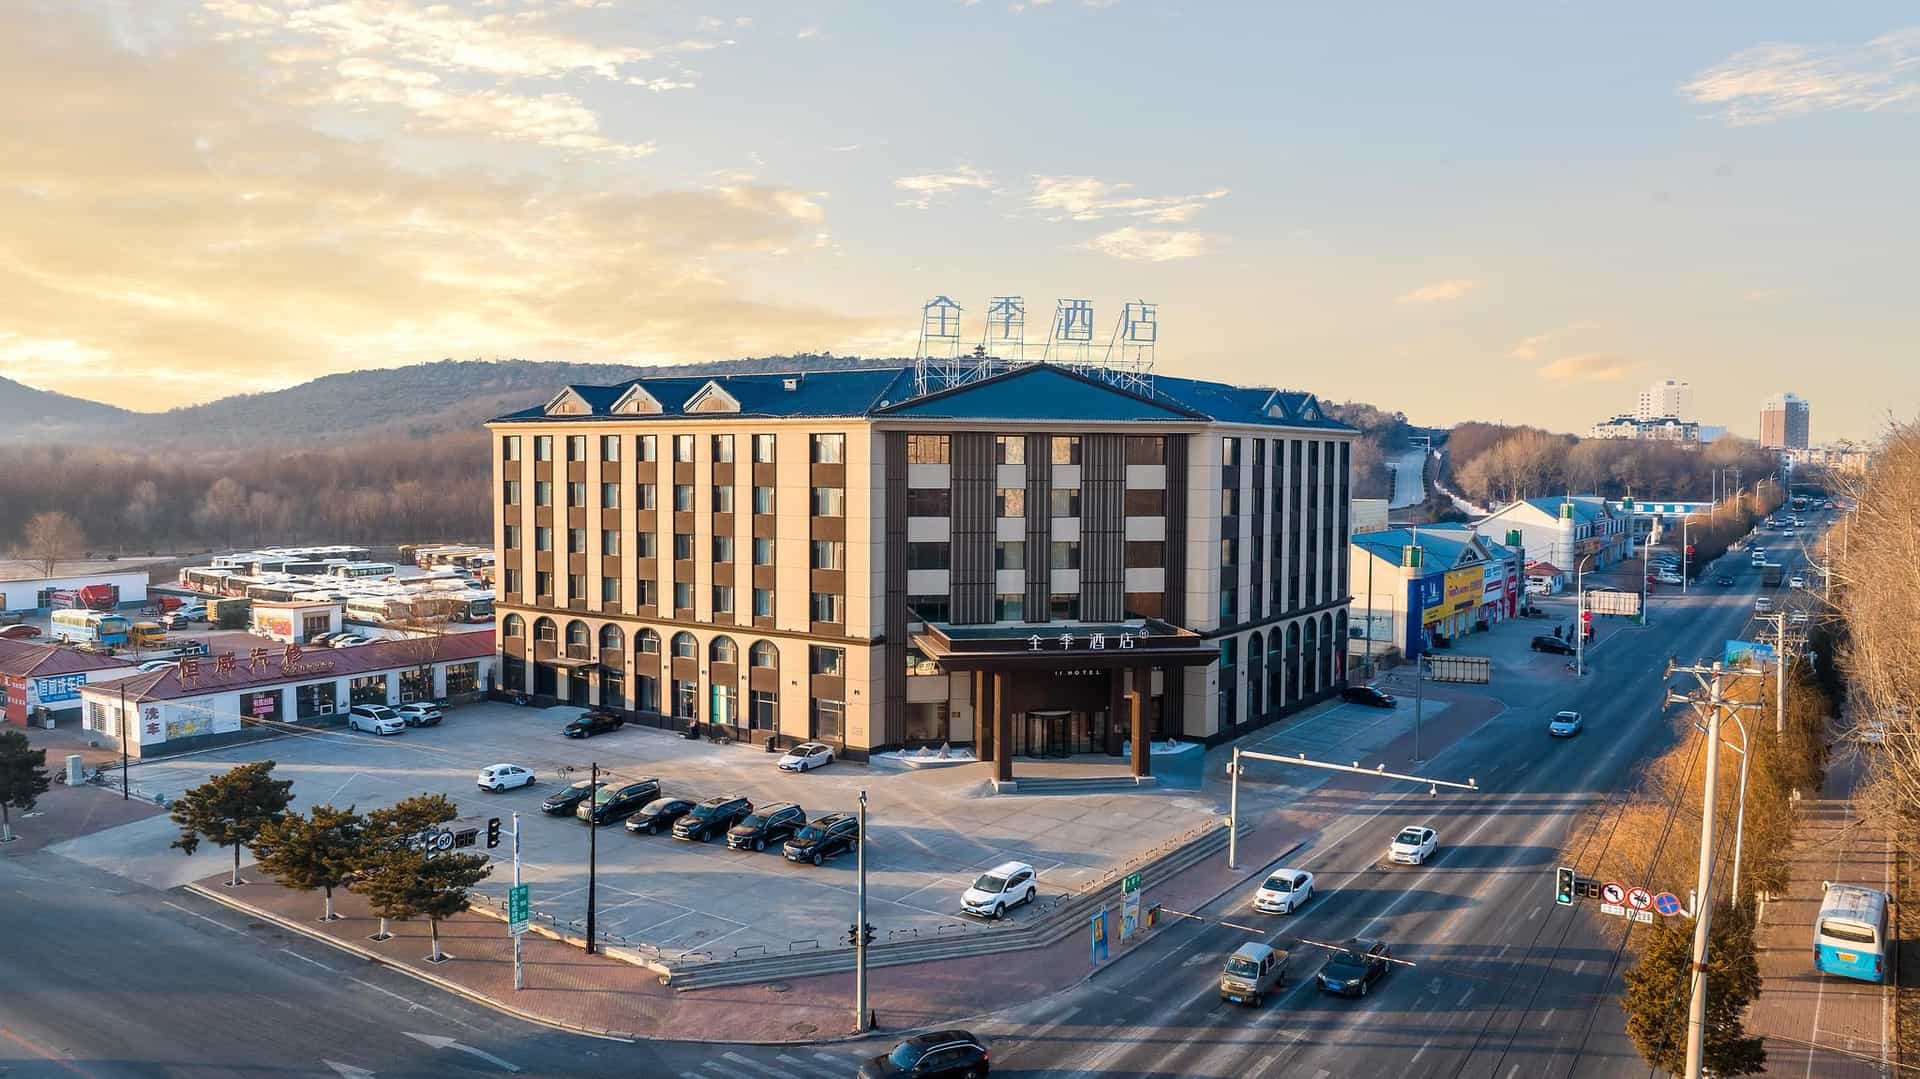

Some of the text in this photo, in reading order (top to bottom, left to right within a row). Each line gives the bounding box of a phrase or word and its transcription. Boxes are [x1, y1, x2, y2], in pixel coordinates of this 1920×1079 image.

[925, 295, 1158, 341] 全季酒店
[1027, 632, 1134, 650] 全季酒店
[144, 707, 160, 735] 洗车
[438, 835, 450, 847] 60
